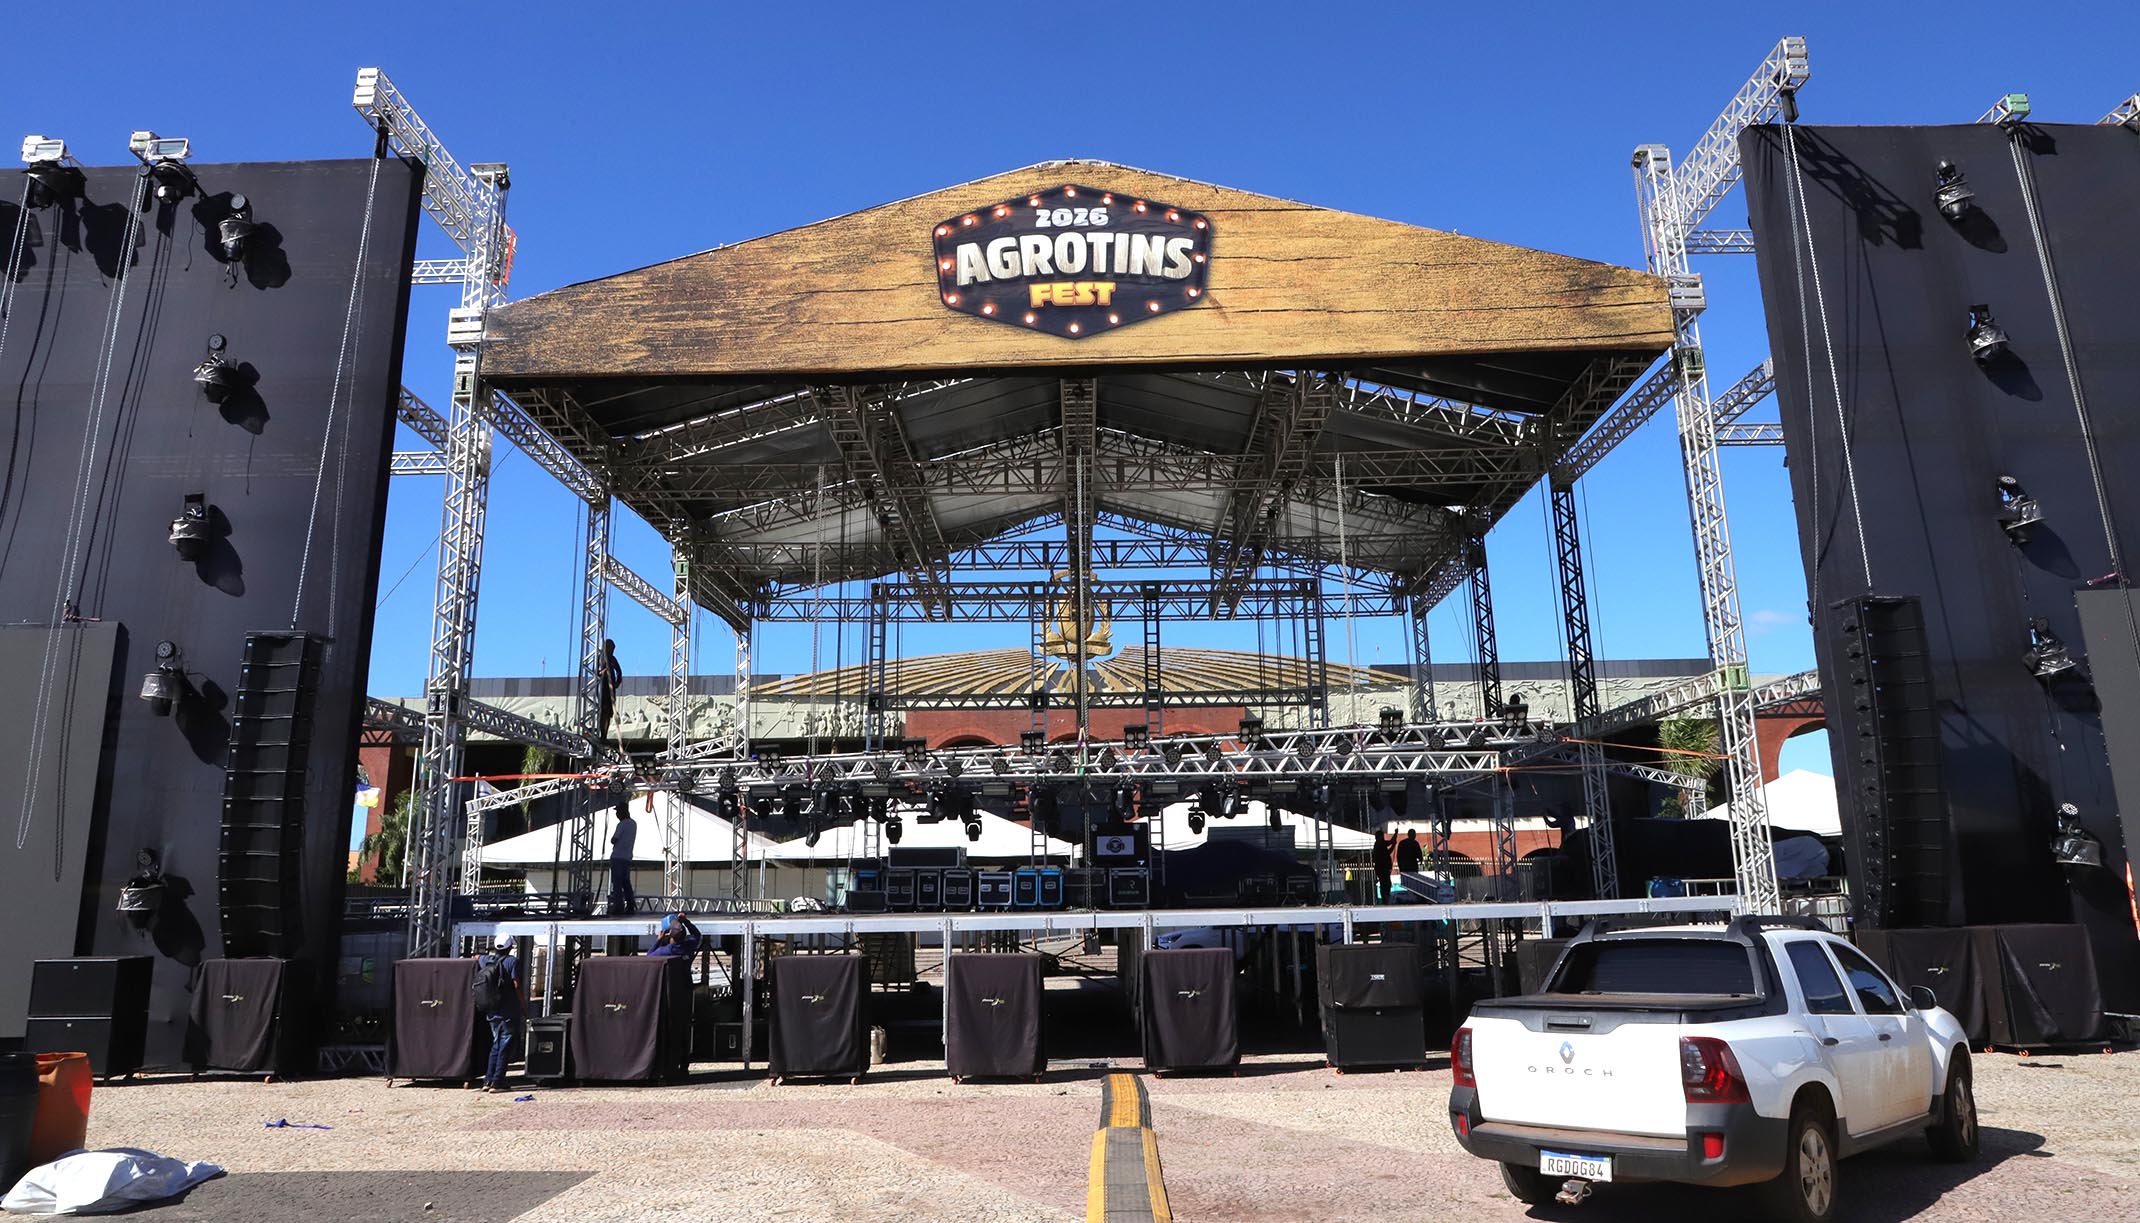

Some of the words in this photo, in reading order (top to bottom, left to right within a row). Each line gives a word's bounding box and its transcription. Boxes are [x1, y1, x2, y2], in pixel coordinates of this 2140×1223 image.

[1035, 207, 1109, 228] 2026
[956, 231, 1194, 286] AGROTINS
[1029, 281, 1117, 308] FEST
[1528, 1065, 1613, 1076] OROCH
